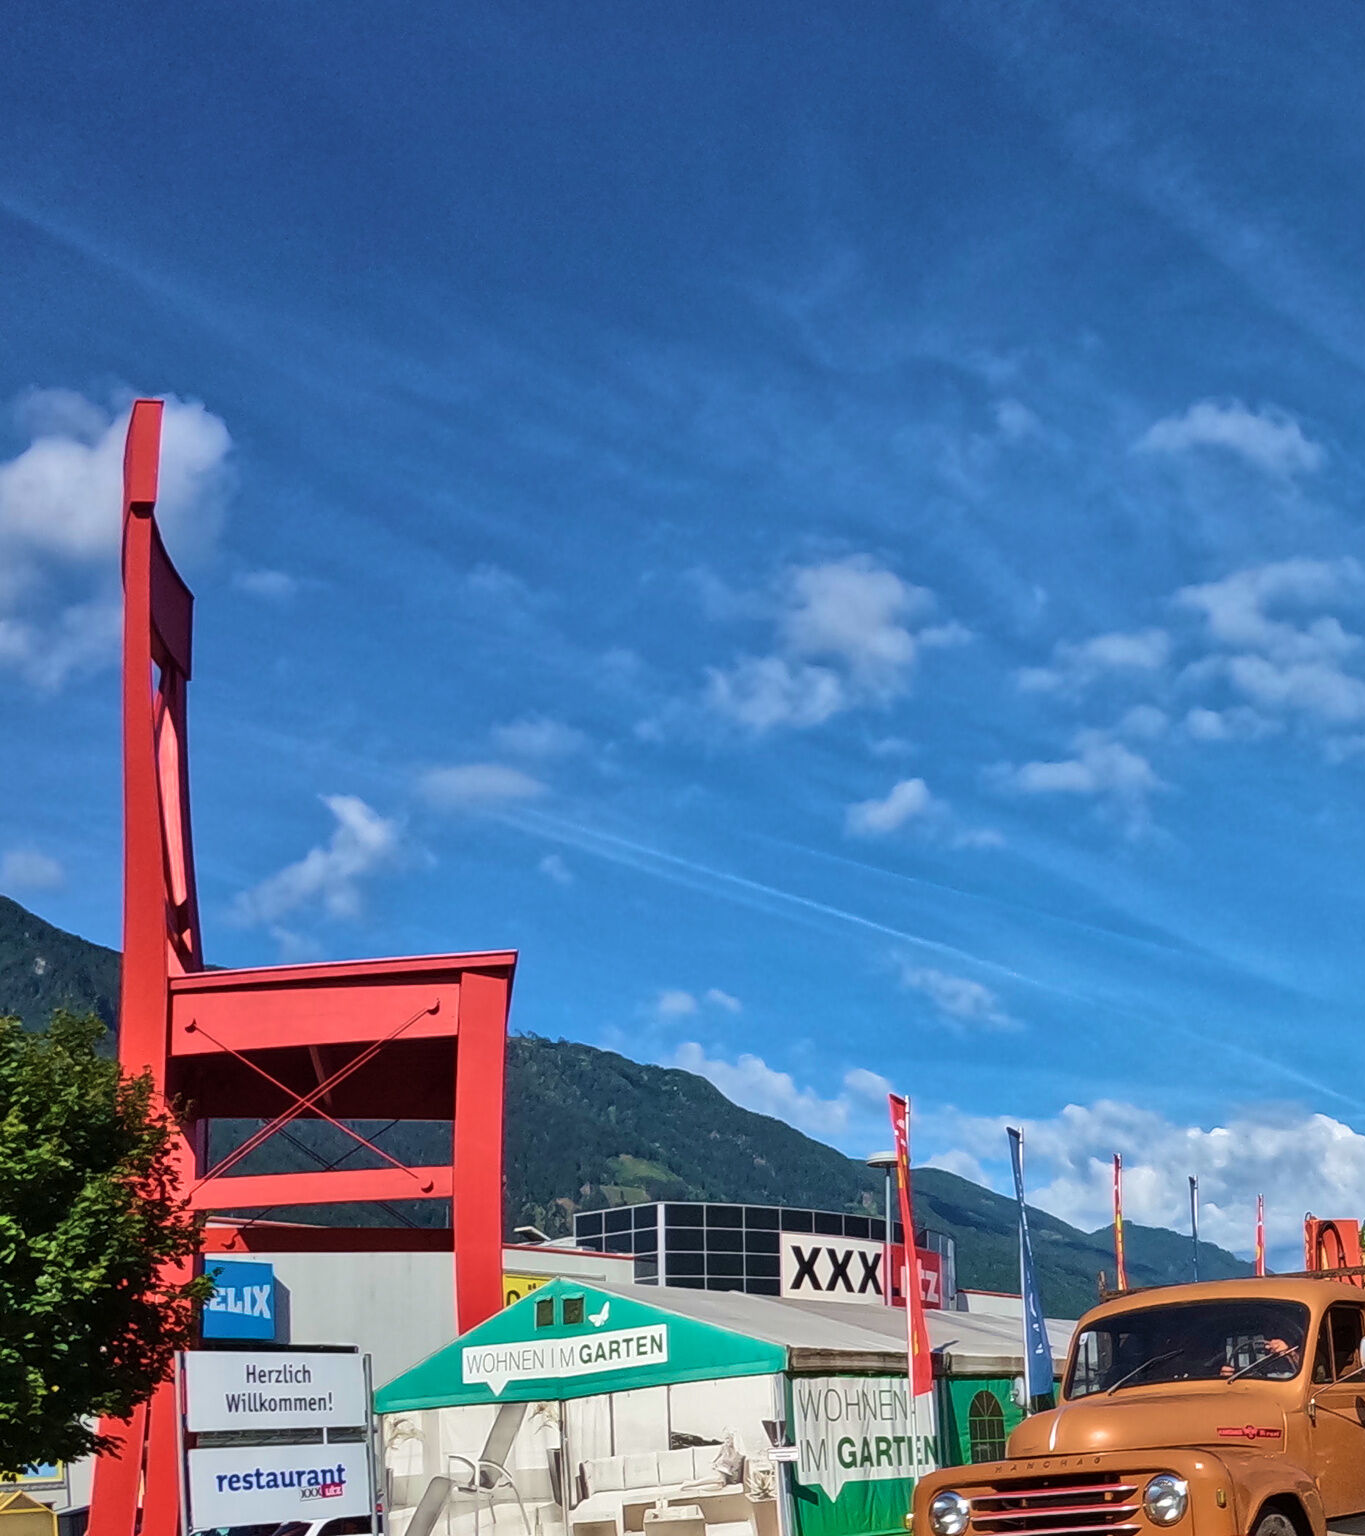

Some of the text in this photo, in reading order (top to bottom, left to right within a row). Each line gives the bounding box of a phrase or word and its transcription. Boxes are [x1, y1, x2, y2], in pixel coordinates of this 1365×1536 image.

[203, 1285, 271, 1319] ELIX
[466, 1348, 545, 1374] WOHNEN
[579, 1333, 664, 1364] GARTEN
[246, 1364, 312, 1384] Herzlich
[225, 1392, 334, 1413] Willkommen!
[798, 1388, 908, 1422] WOHNEN
[800, 1435, 938, 1472] IM GARTEN
[216, 1464, 346, 1492] restaurant
